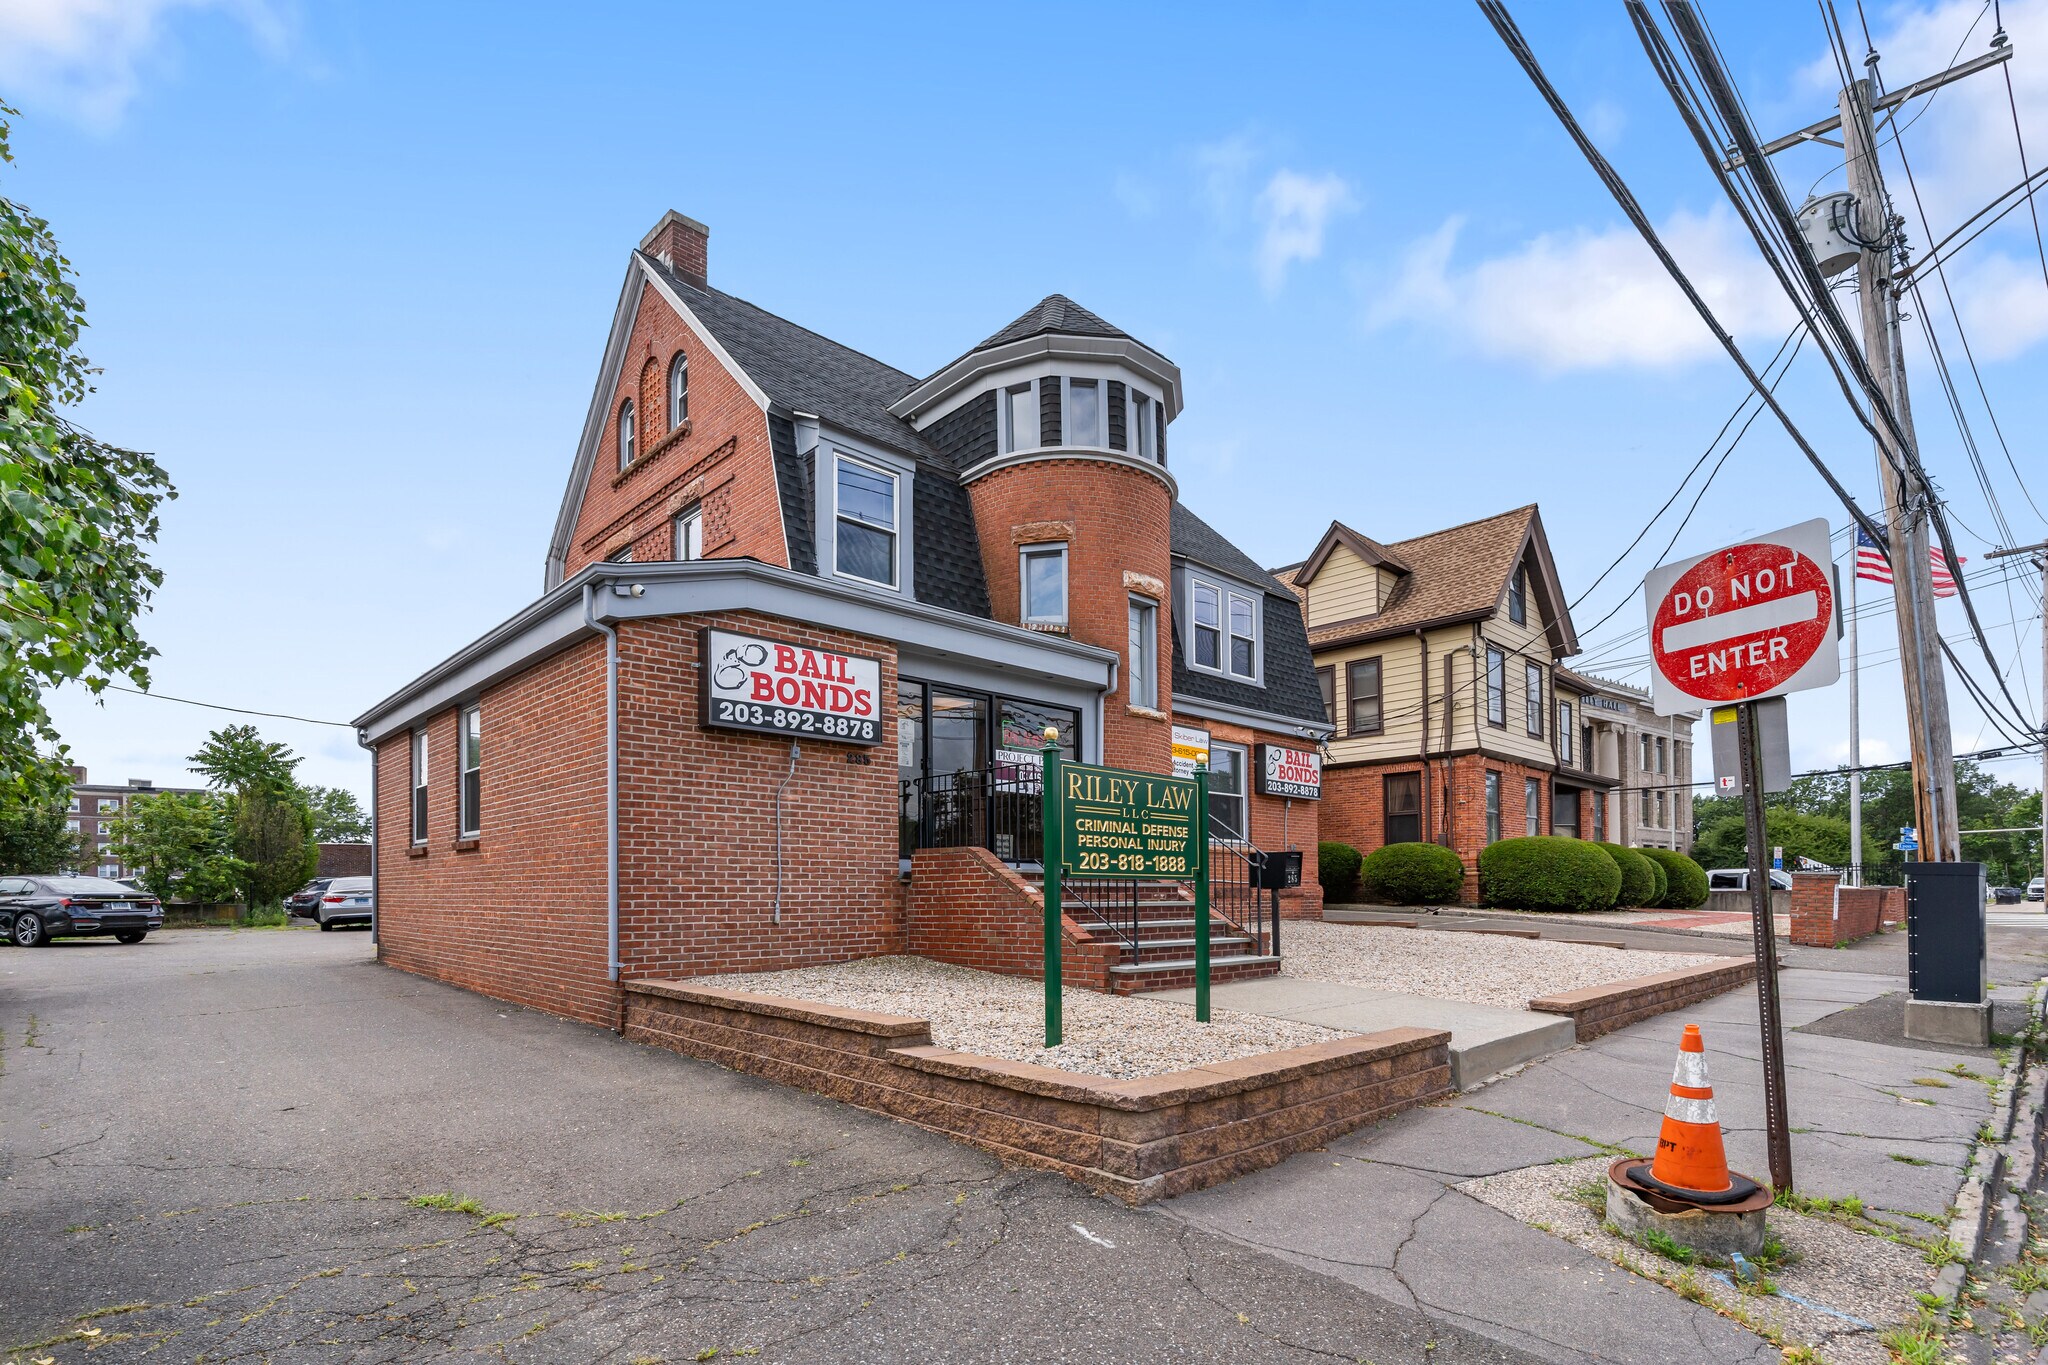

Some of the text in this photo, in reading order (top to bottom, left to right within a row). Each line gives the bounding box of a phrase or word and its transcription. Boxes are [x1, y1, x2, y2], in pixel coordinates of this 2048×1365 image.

[1674, 562, 1797, 616] DO NOT
[774, 644, 855, 685] BAIL
[1689, 636, 1789, 679] ENTER
[750, 671, 872, 716] BONDS
[1602, 699, 1620, 712] HALL
[719, 702, 874, 739] 203-892-8878
[998, 750, 1035, 763] PROJECT
[1173, 760, 1194, 769] Accident
[1285, 749, 1312, 768] BAIL
[1278, 764, 1318, 784] BONDS
[1068, 772, 1139, 805] RILEY
[1146, 782, 1194, 811] LAW
[1267, 781, 1319, 797] 203-892-8878
[1075, 818, 1189, 838] CRIMINAL DEFENSE
[1078, 834, 1187, 852] PERSONAL INJURY
[1079, 852, 1186, 872] 203-818-1888
